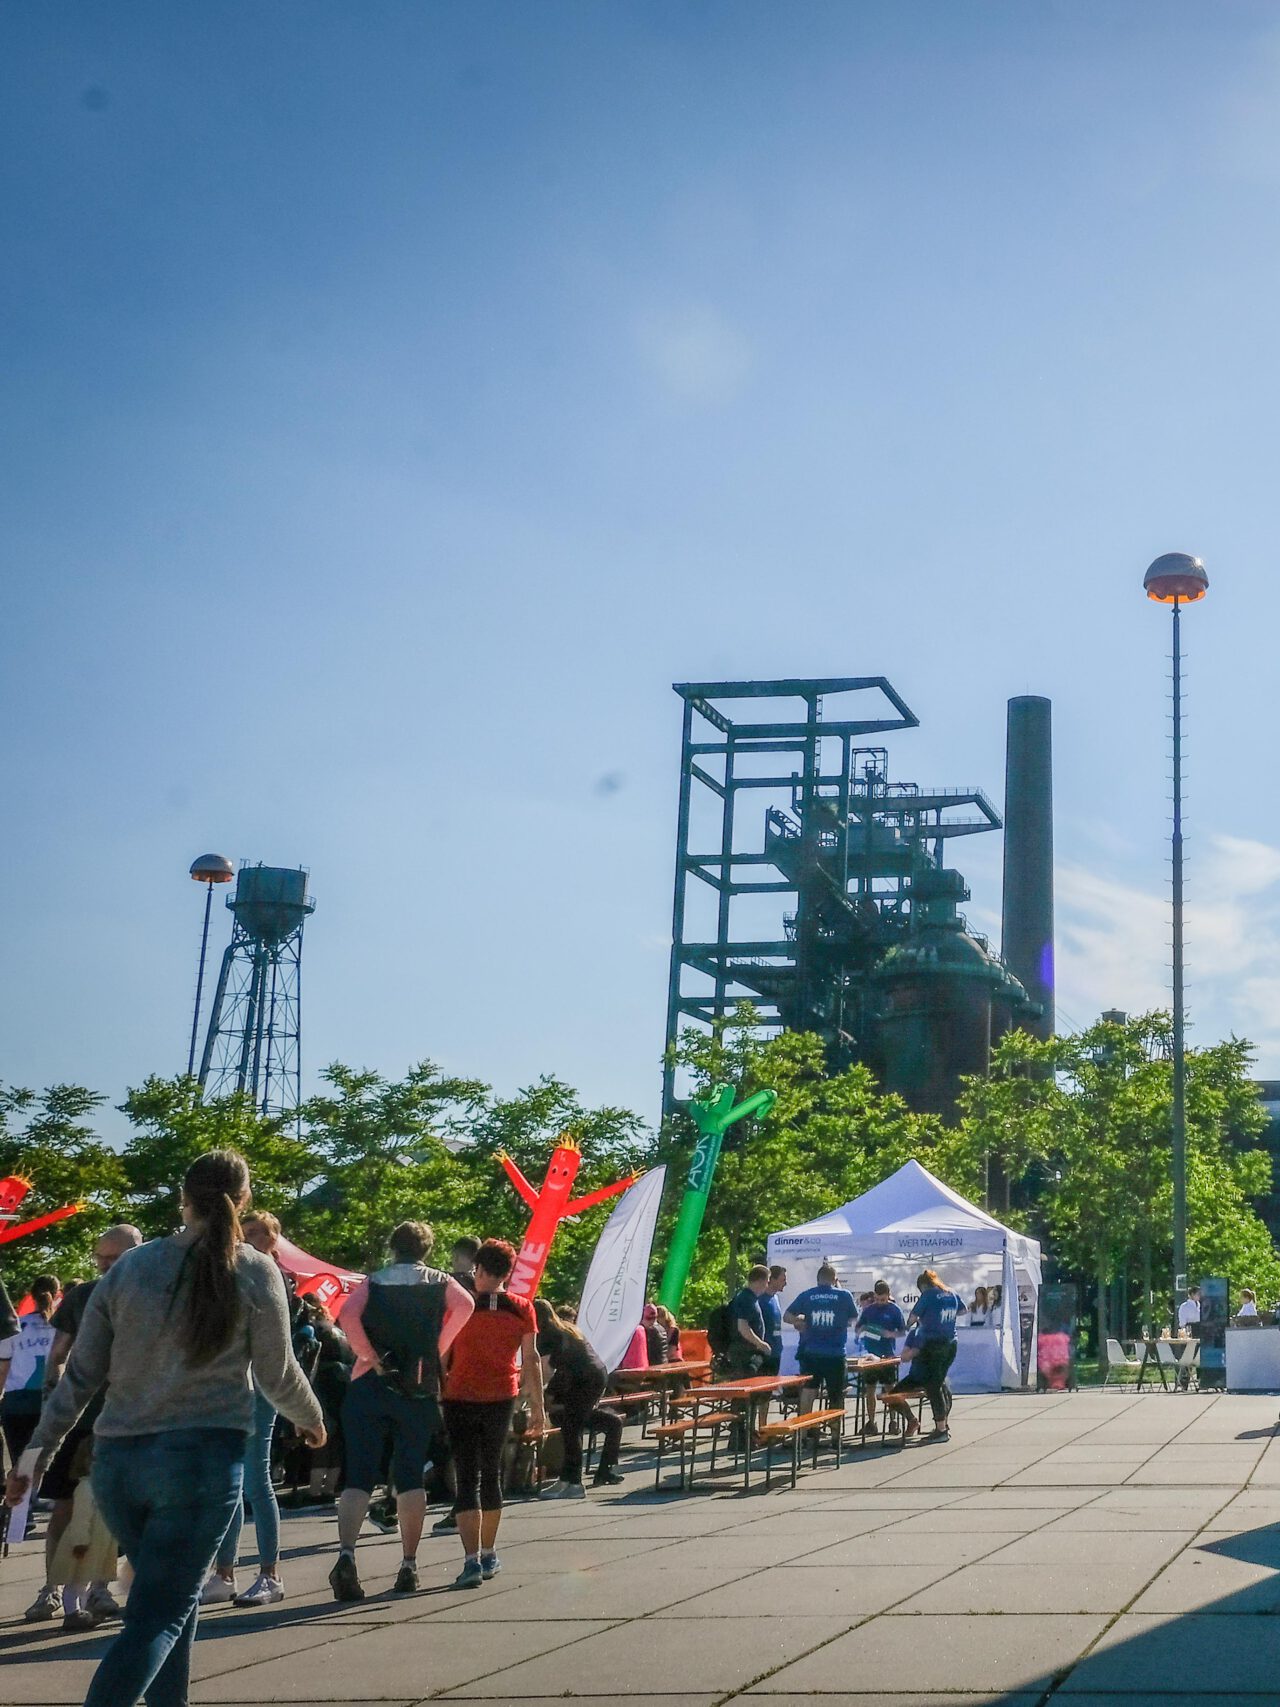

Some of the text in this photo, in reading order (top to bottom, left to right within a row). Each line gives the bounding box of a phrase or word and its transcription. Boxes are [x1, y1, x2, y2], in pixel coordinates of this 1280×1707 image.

[898, 1237, 963, 1248] WERTMARKEN
[507, 1240, 545, 1296] WE
[810, 1293, 839, 1301] CONDOR
